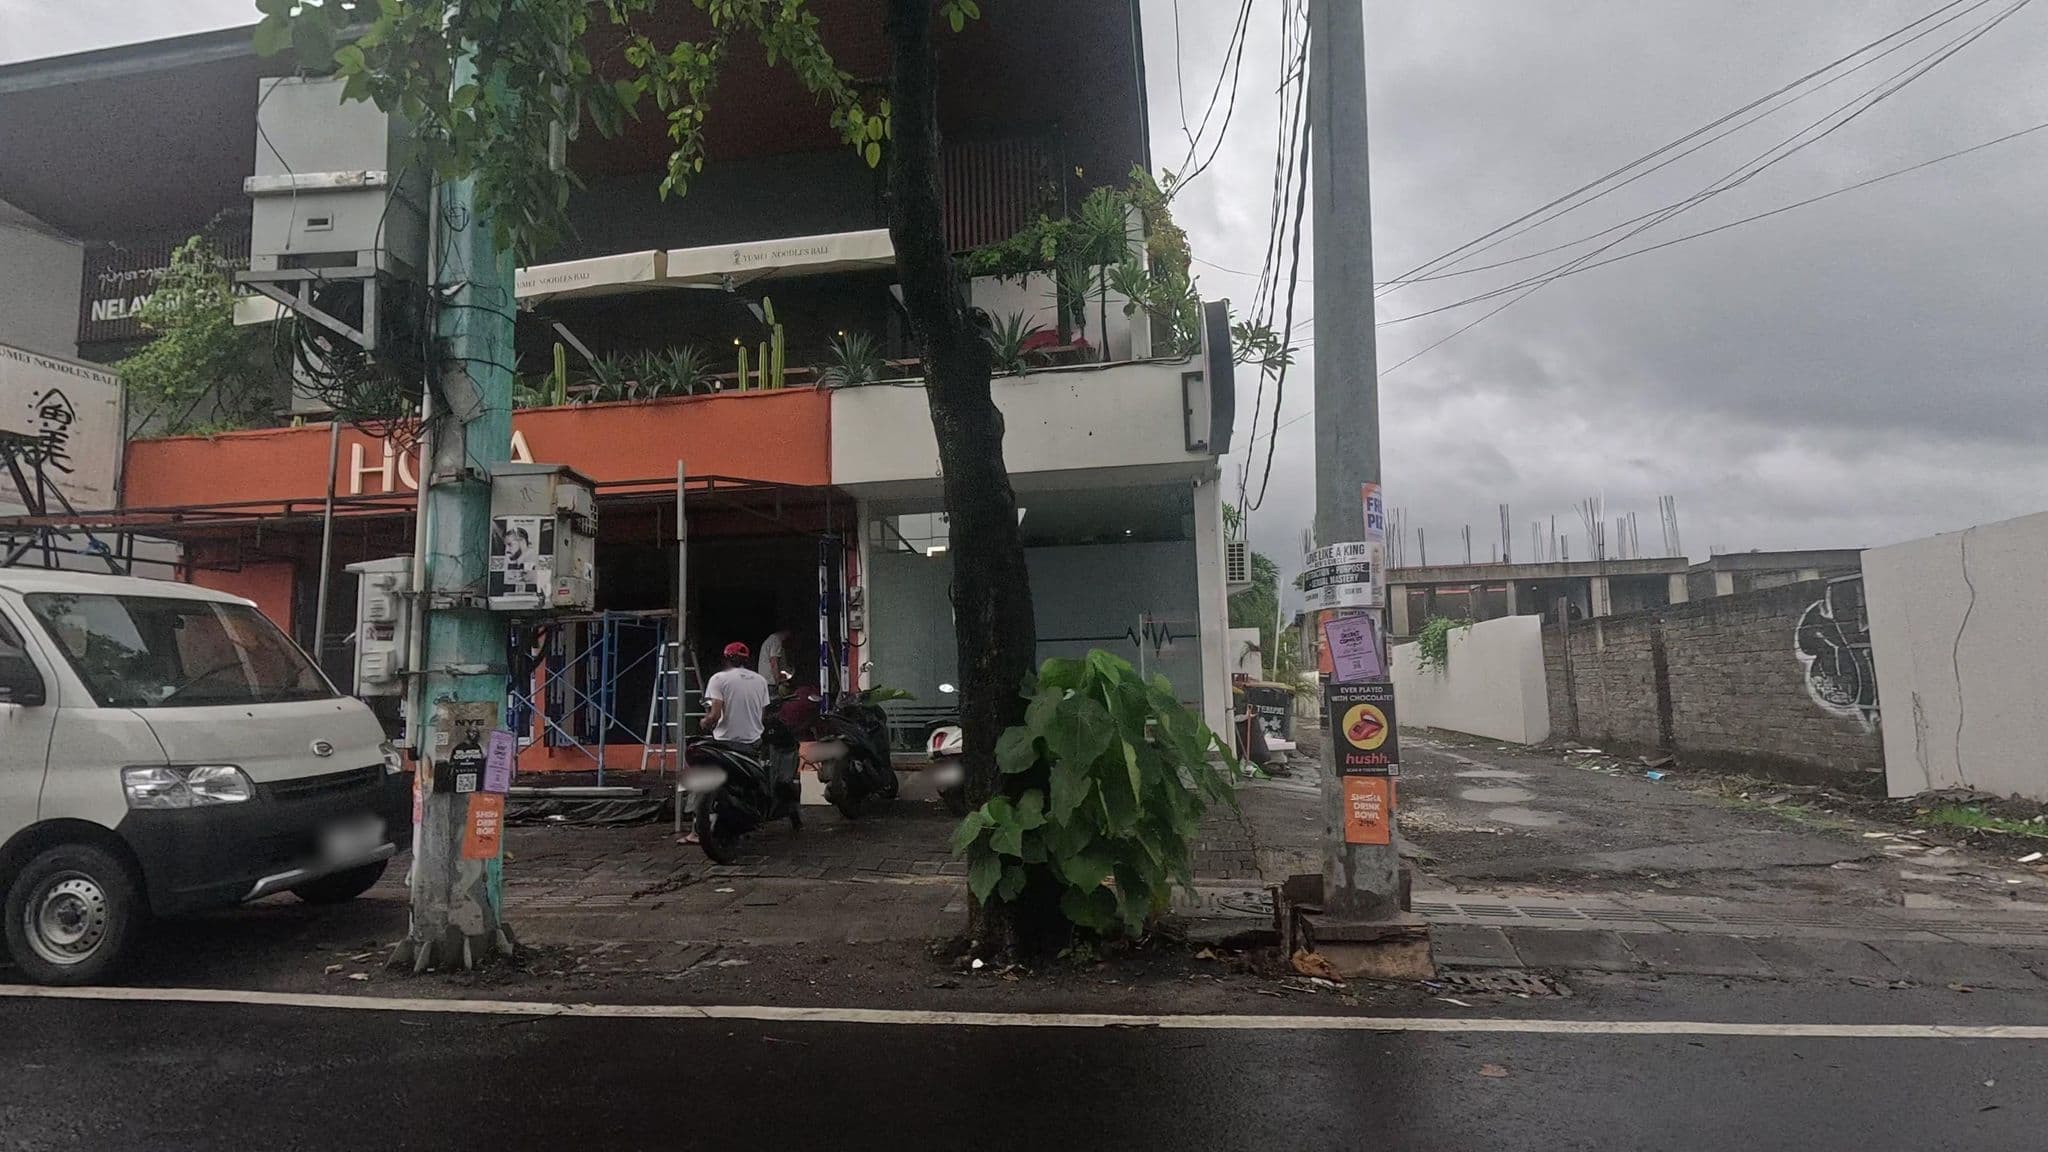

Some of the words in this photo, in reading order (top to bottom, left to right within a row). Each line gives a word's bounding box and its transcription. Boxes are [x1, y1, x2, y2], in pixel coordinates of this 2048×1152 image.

[771, 248, 811, 258] NOODLES
[811, 246, 829, 256] BALI
[539, 275, 573, 284] NOODLES
[573, 272, 590, 280] BALI
[34, 357, 90, 379] NOODLES
[92, 373, 119, 386] BALI
[1319, 546, 1333, 561] LIKE
[1335, 547, 1342, 557] A
[1344, 543, 1365, 557] KING
[1329, 573, 1359, 584] MASTERY
[1340, 686, 1358, 694] EVER
[1353, 802, 1380, 810] DRINK
[1354, 811, 1380, 820] BOWL
